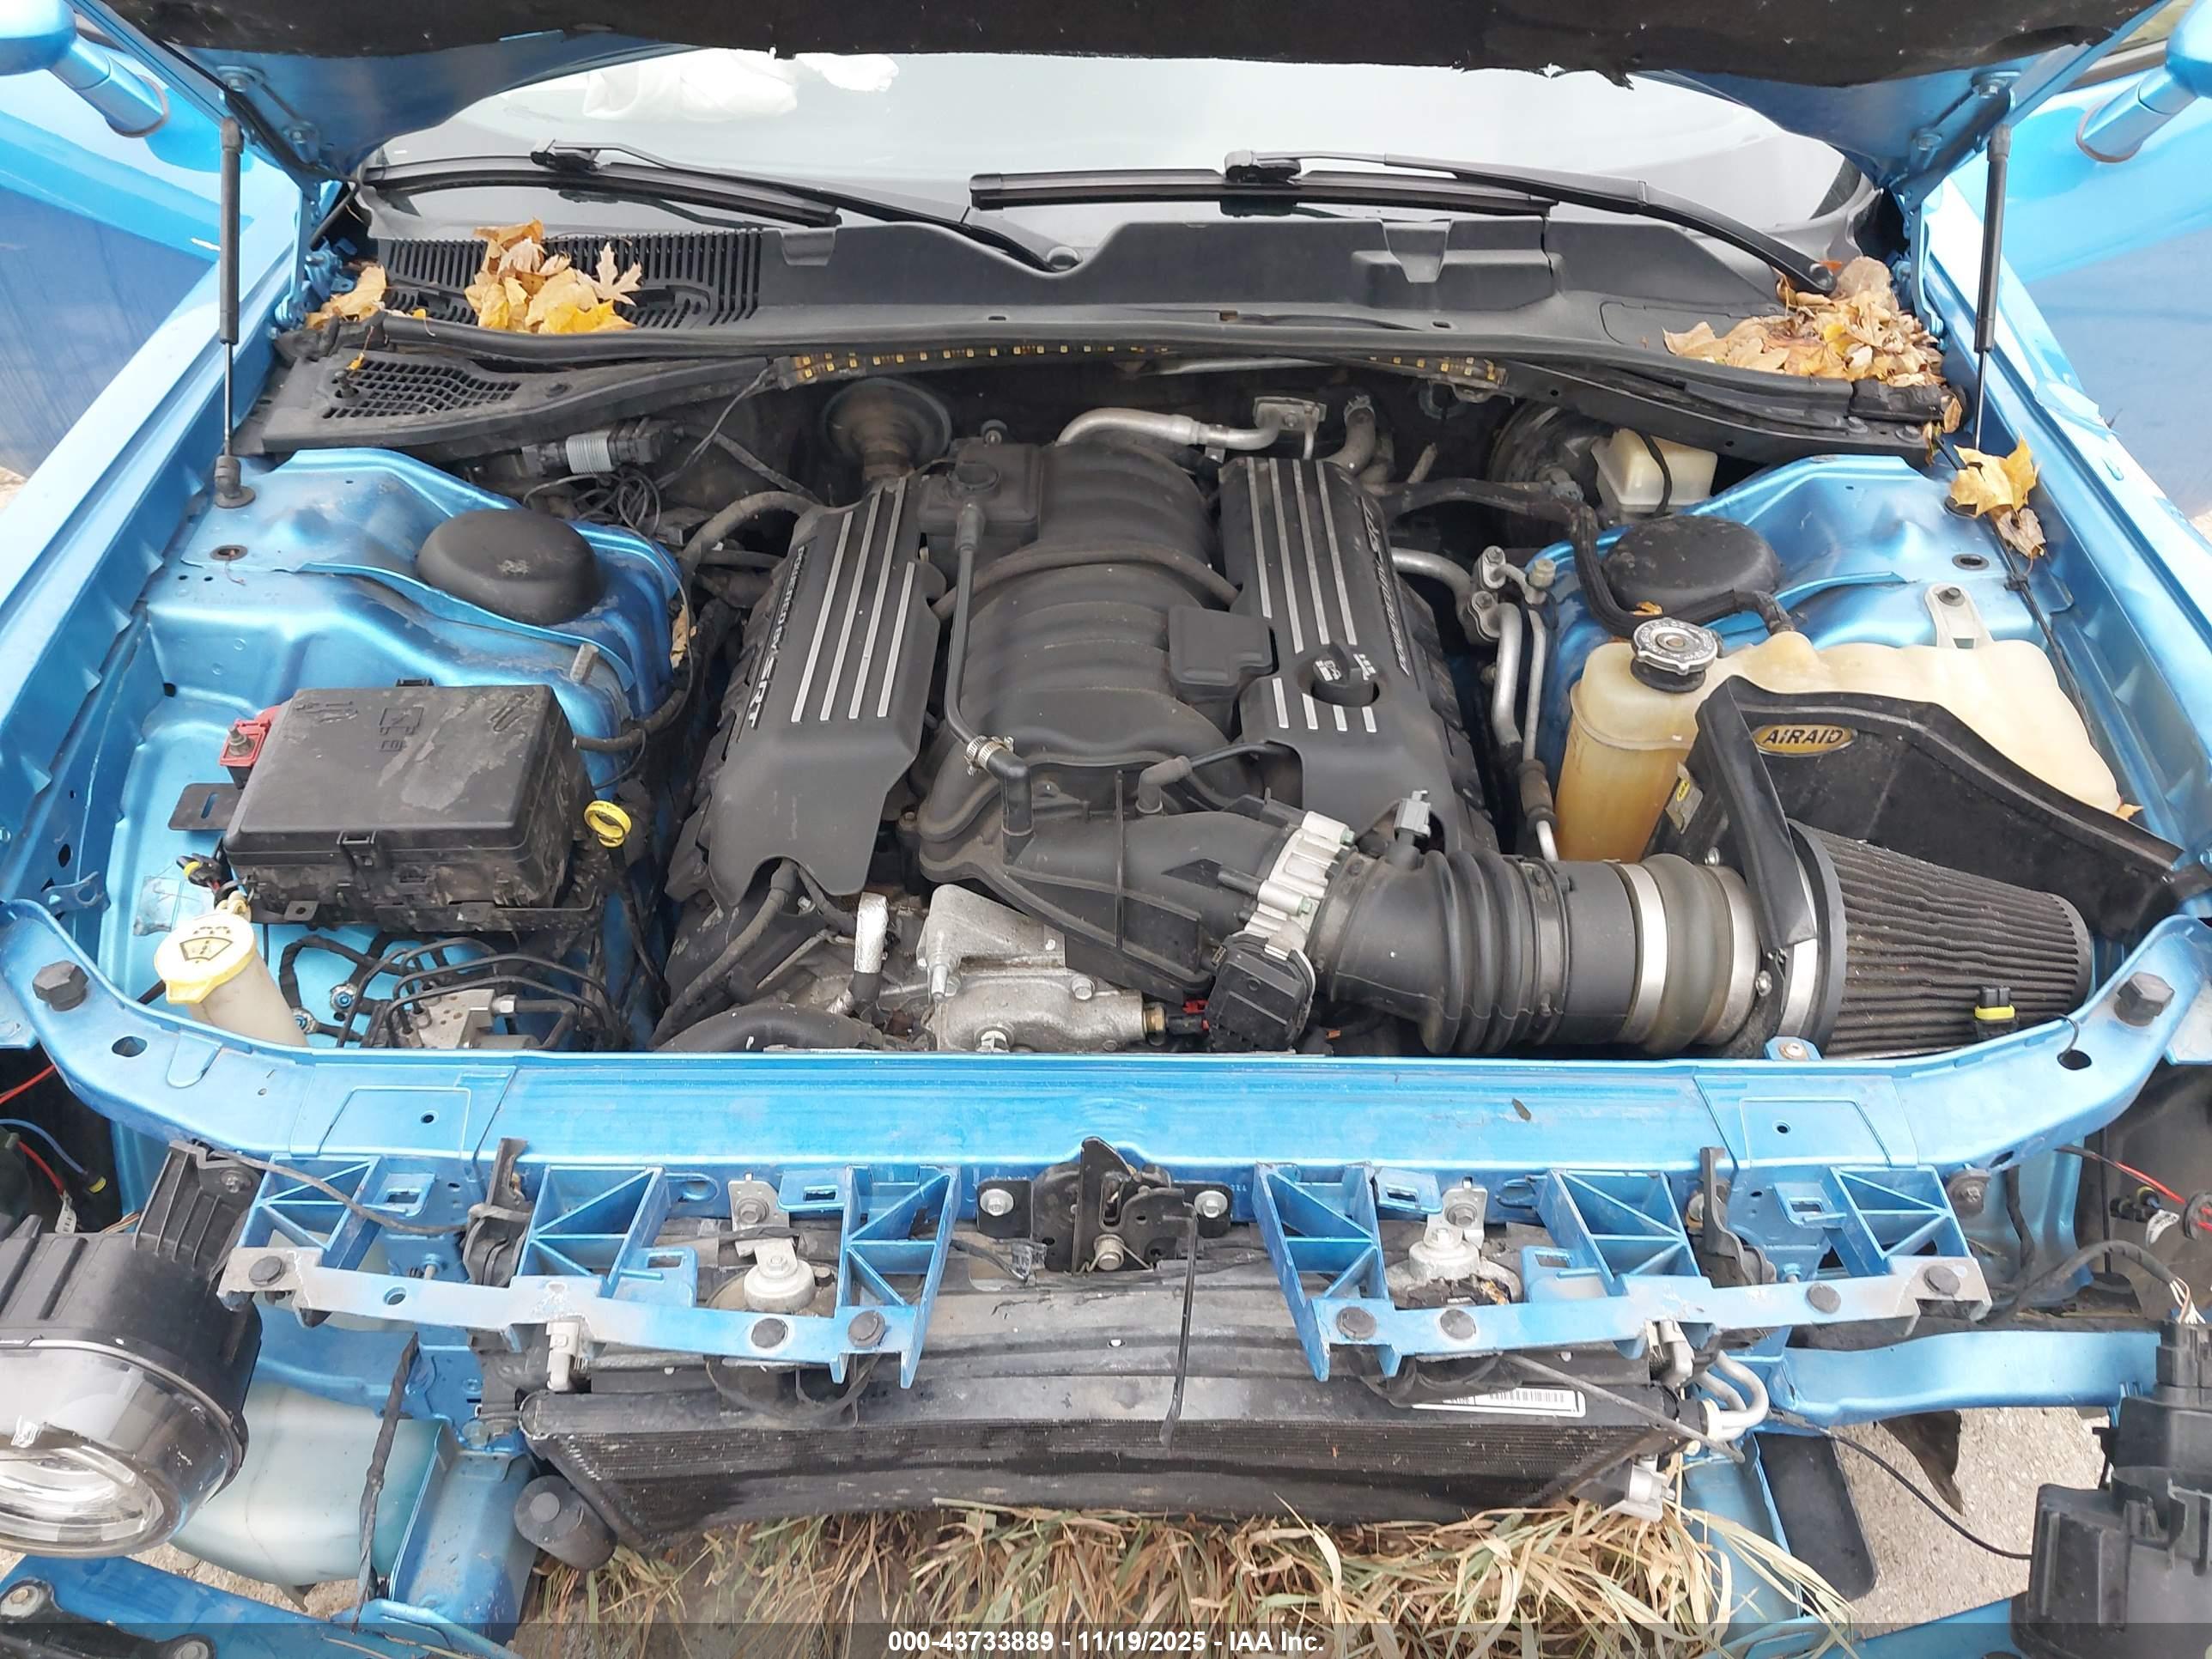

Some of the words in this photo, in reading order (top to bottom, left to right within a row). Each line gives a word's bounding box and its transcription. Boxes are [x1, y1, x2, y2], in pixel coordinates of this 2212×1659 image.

[778, 545, 805, 625] POWERED
[771, 626, 783, 653] BY
[749, 656, 775, 728] SRT
[1763, 729, 1844, 744] AIRAID
